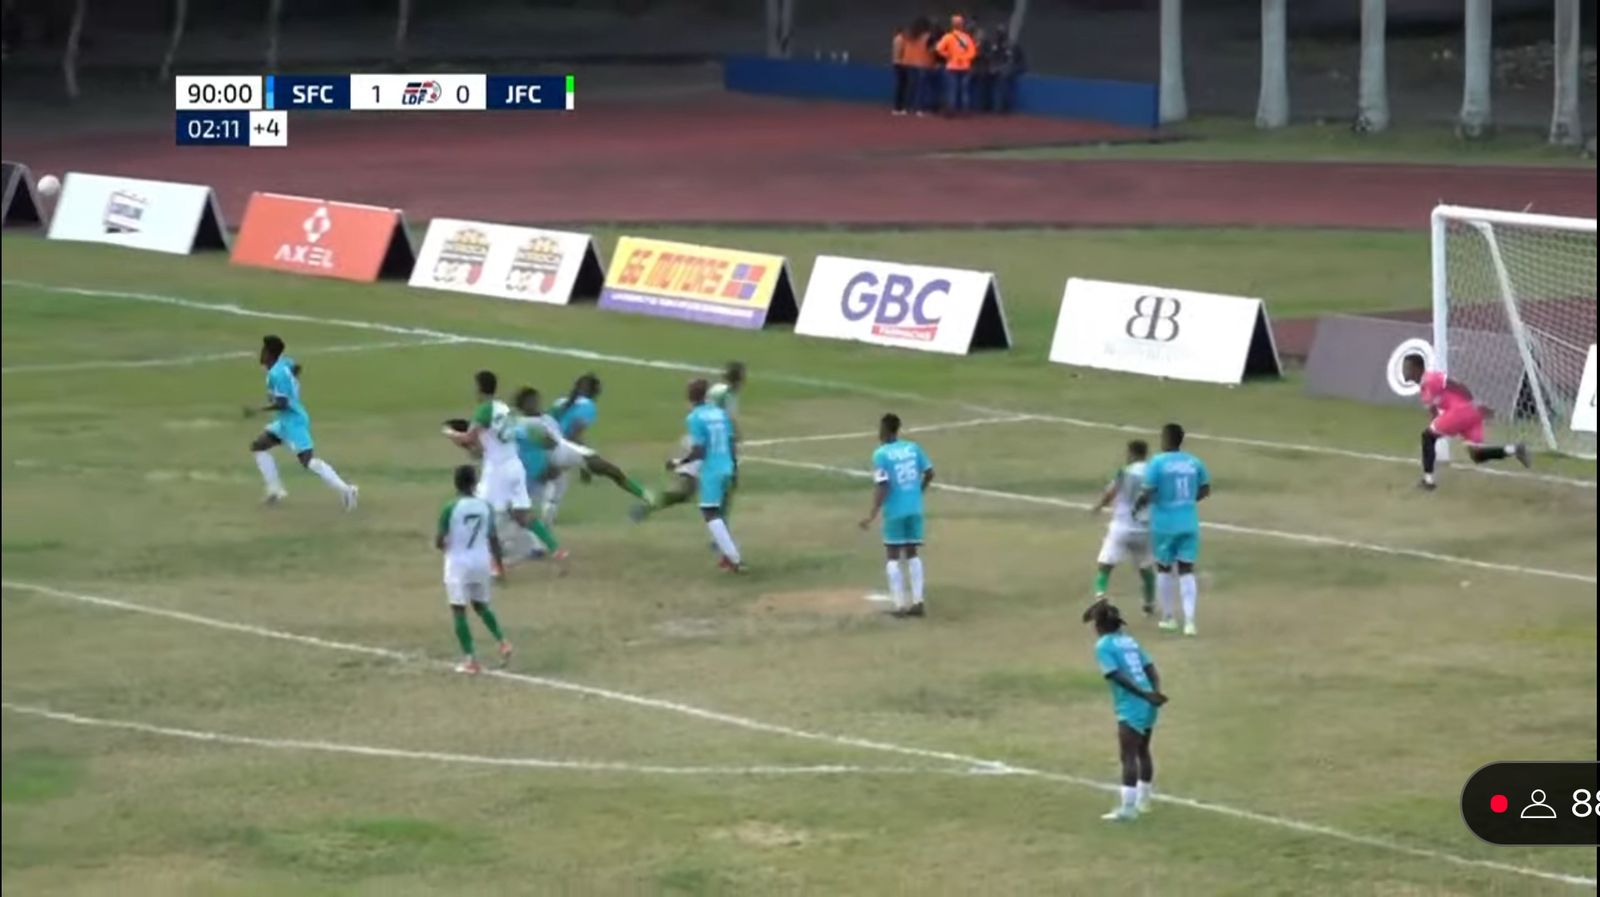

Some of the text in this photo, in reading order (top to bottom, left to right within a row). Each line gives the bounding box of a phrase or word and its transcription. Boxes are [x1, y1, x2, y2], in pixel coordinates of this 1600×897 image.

[274, 243, 334, 268] AXEL
[840, 271, 952, 326] GBC
[463, 513, 482, 549] 7
